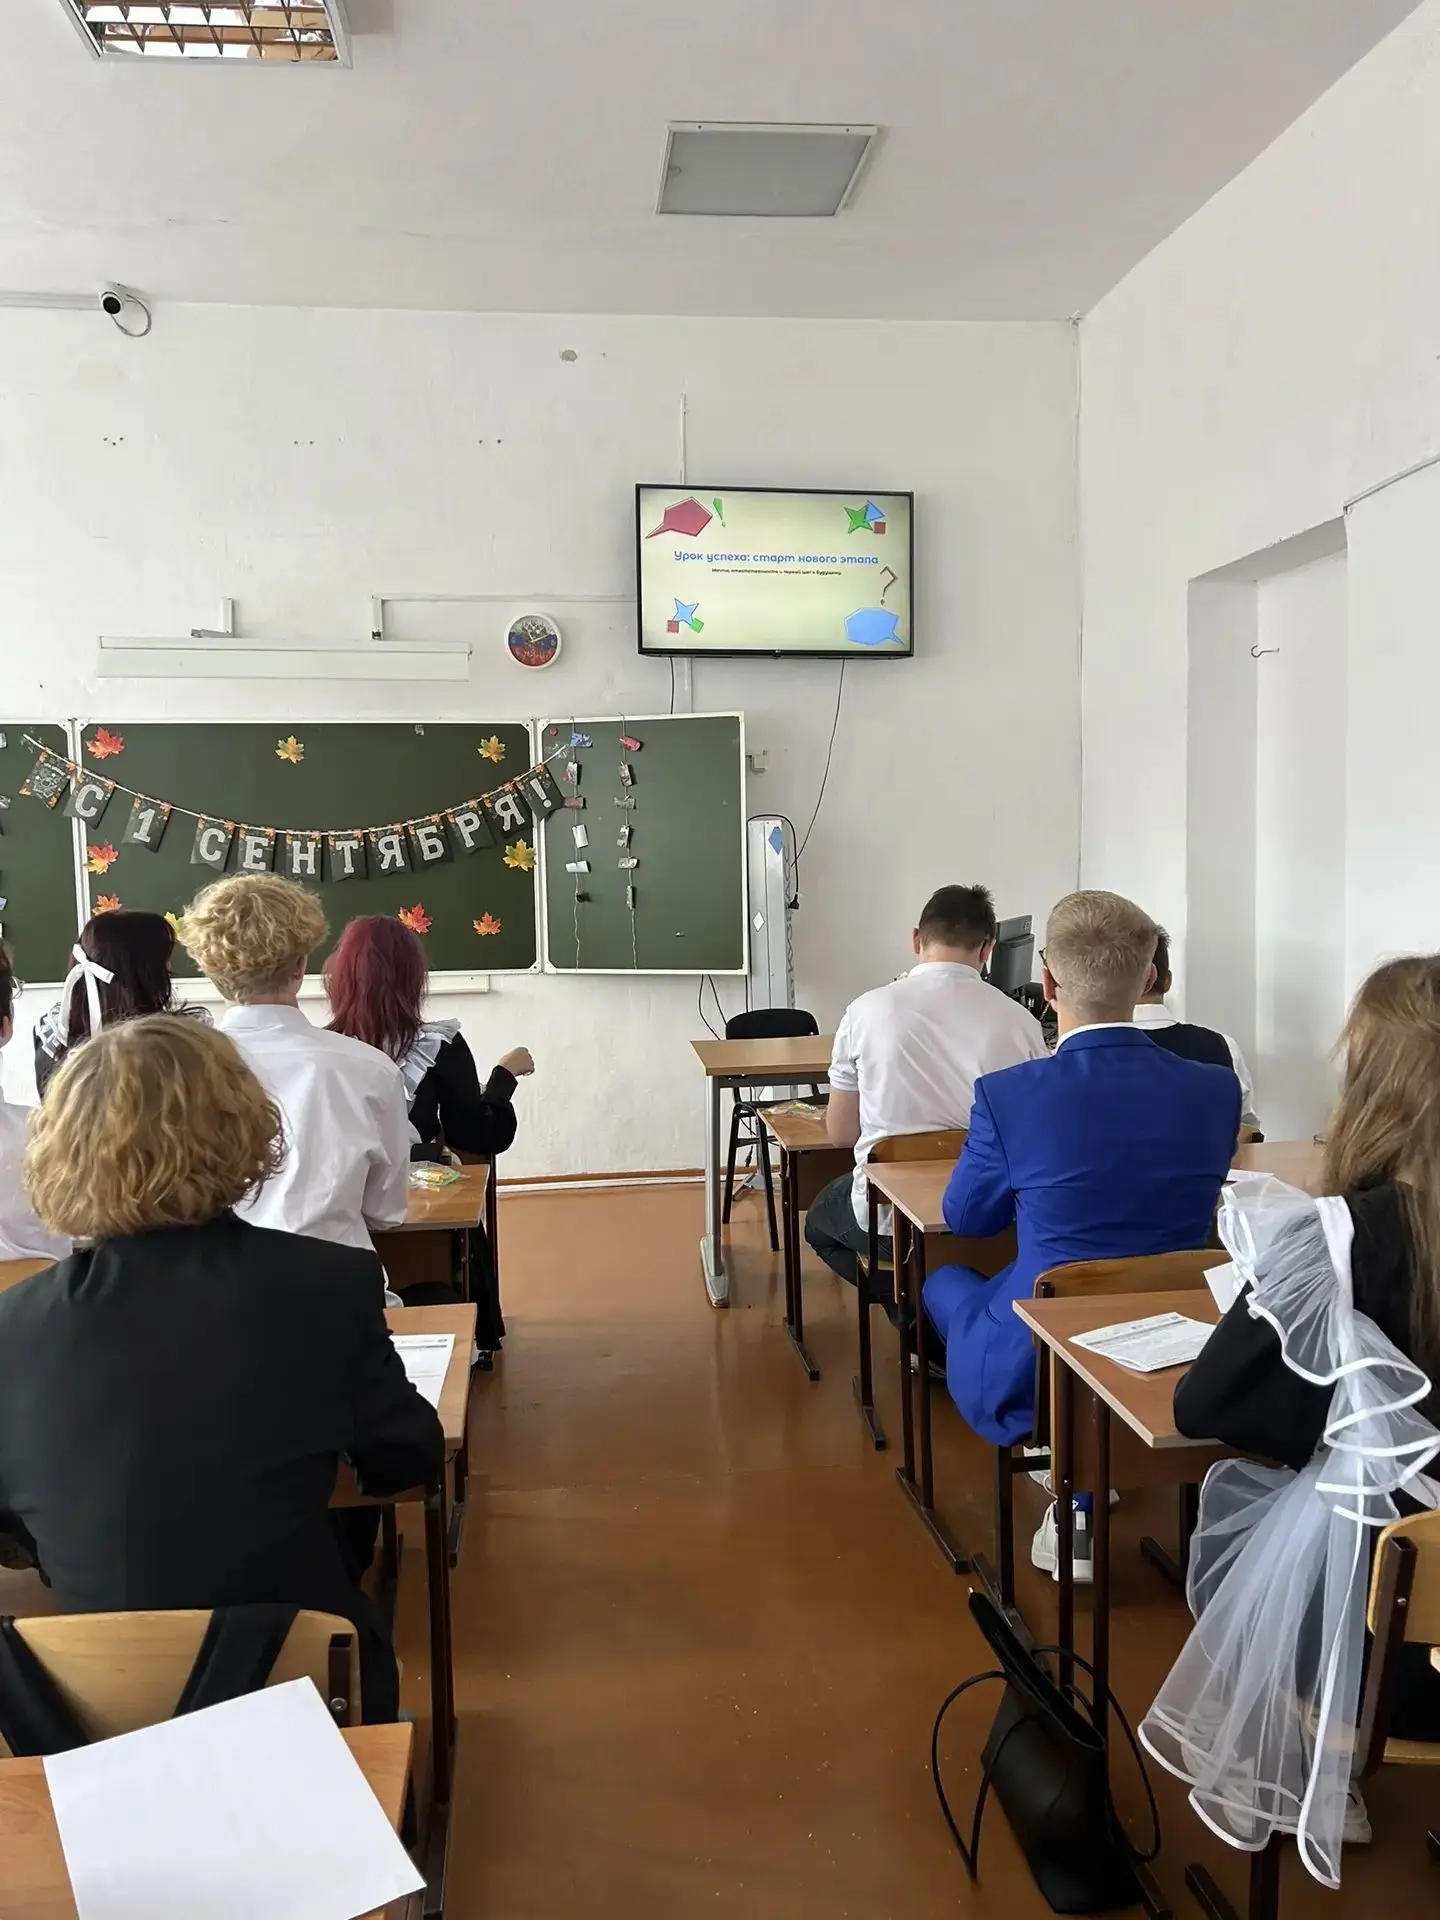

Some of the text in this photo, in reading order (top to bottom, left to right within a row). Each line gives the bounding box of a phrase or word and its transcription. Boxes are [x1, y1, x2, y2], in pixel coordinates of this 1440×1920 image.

[674, 551, 879, 564] Урок успеха: старт нового этапа
[75, 777, 552, 874] С 1 СЕНТЯБРЯ!
